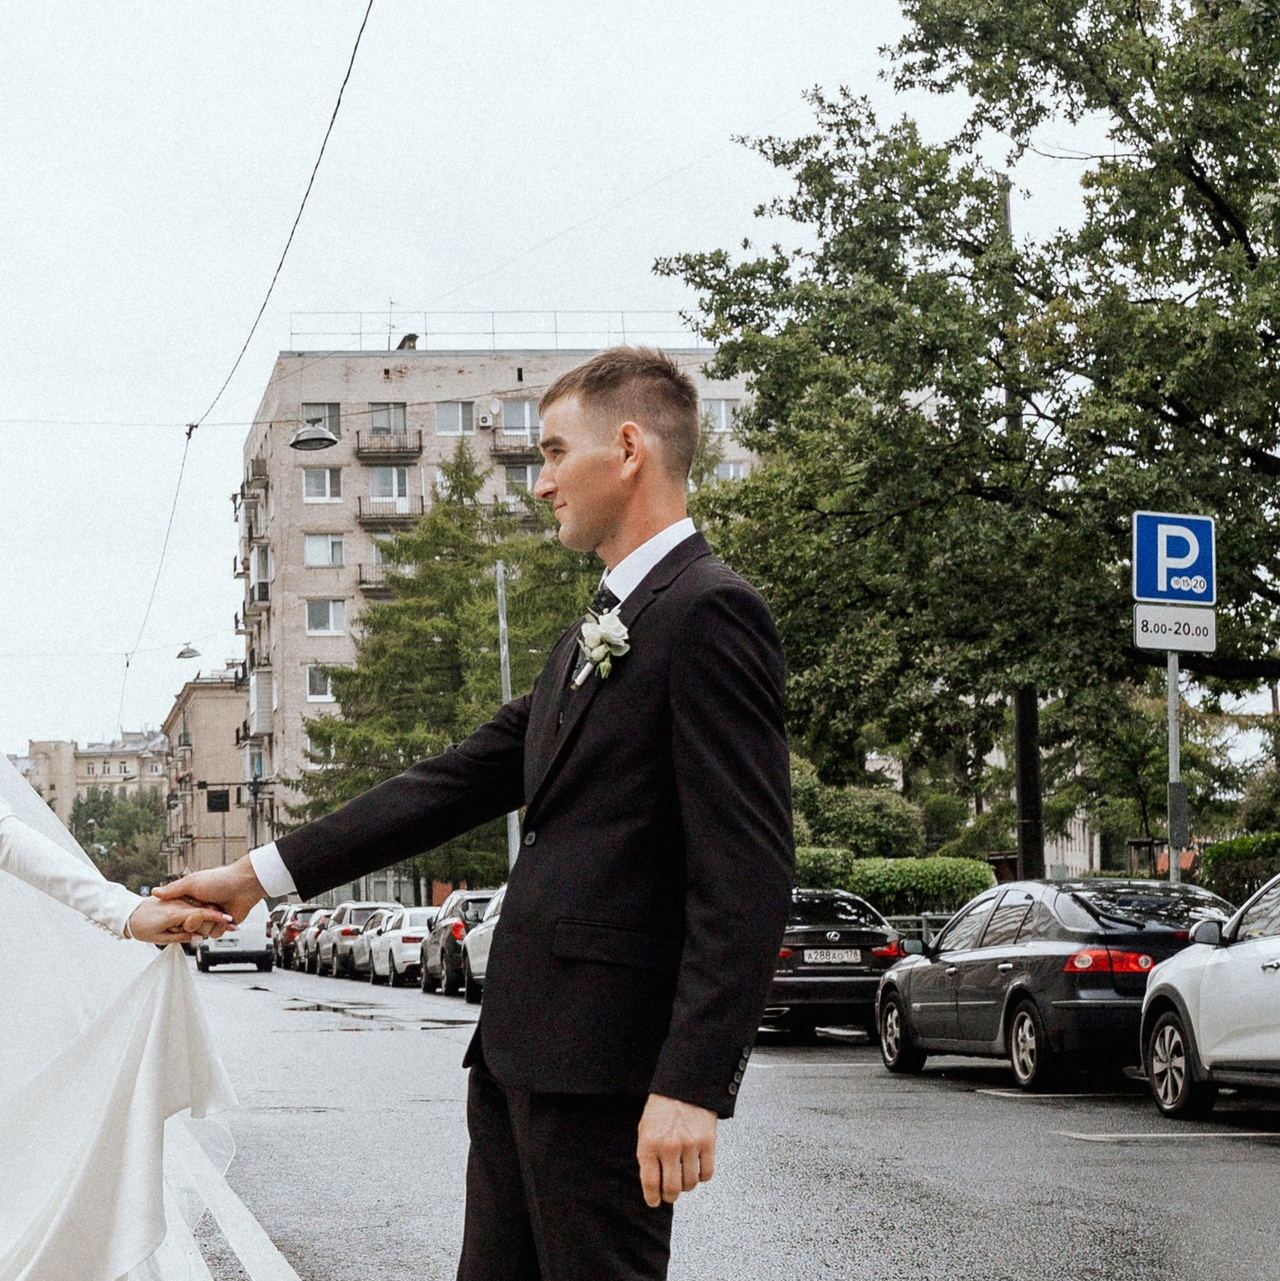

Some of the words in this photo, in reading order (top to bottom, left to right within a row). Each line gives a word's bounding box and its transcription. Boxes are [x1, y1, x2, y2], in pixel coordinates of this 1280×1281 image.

[1157, 523, 1200, 592] P
[1182, 578, 1190, 587] 15
[1193, 578, 1206, 590] 20
[1140, 619, 1209, 637] 8.00-20.00
